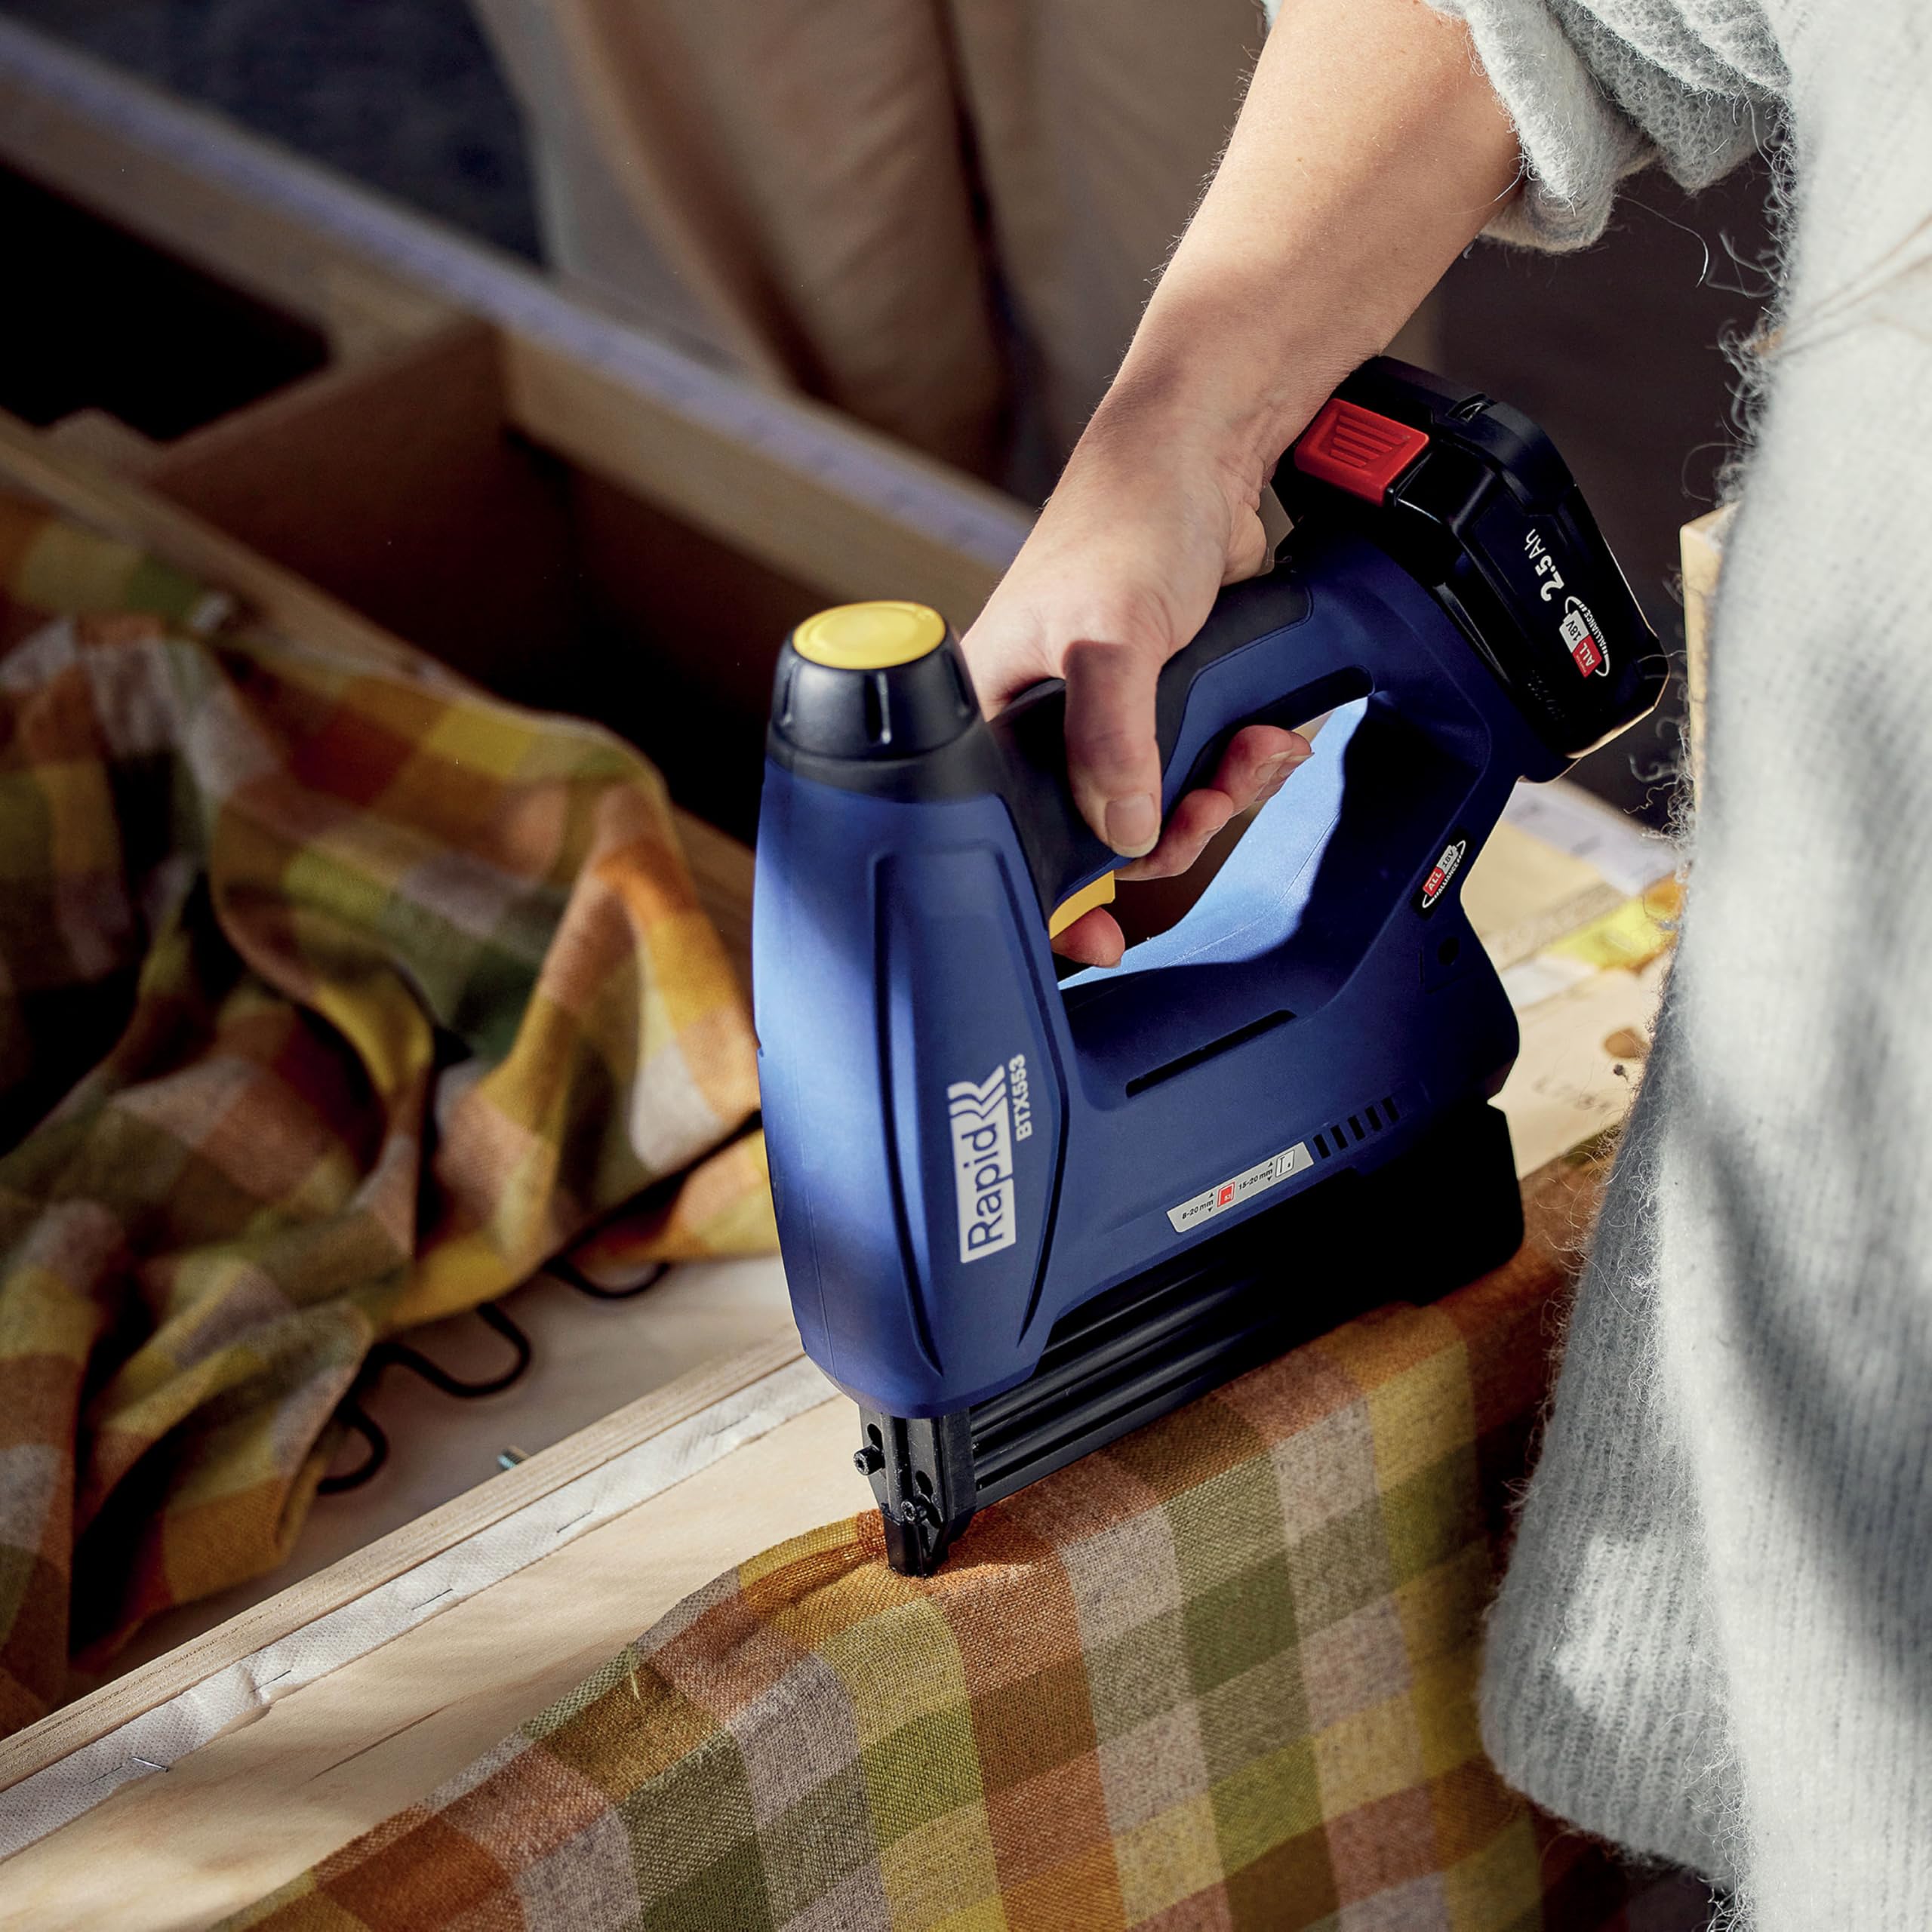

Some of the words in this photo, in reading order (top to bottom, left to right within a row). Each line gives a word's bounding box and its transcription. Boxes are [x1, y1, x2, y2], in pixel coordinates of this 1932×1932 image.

[1524, 528, 1546, 559] Ah
[1535, 555, 1564, 601] 2.5
[1566, 620, 1582, 641] 18V
[1583, 609, 1607, 647] ALLIANCE
[1580, 642, 1595, 666] ALL
[1429, 872, 1442, 891] ALL
[1442, 850, 1455, 868] 18V
[1438, 863, 1459, 894] ALLIANCE
[1008, 1054, 1033, 1142] BTX553
[961, 1121, 1013, 1251] Rapid
[1238, 1174, 1259, 1190] 15-20
[1259, 1168, 1273, 1180] mm
[1182, 1206, 1198, 1220] 8-20
[1198, 1199, 1214, 1211] mm
